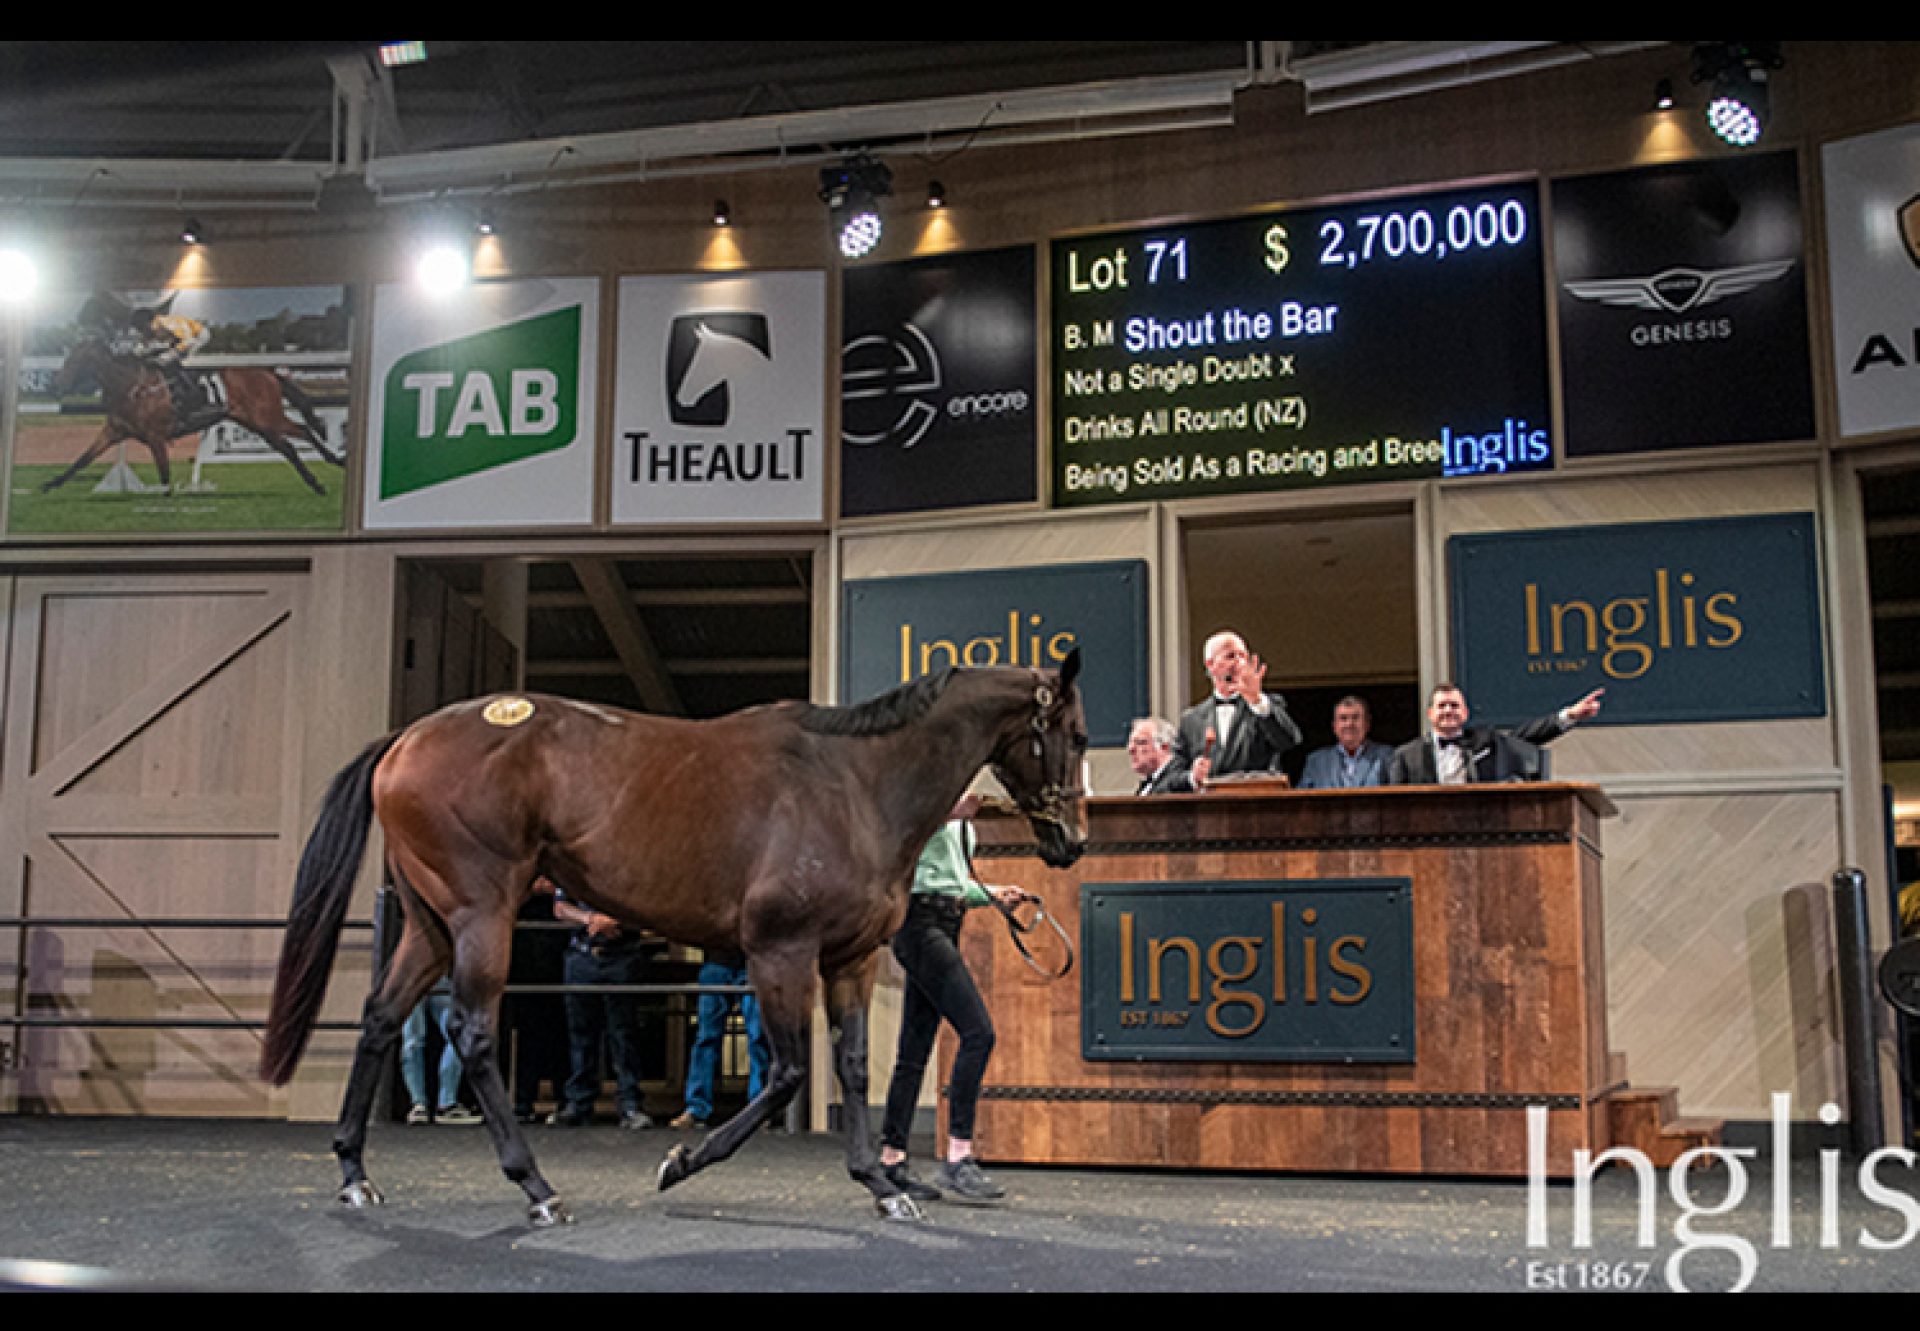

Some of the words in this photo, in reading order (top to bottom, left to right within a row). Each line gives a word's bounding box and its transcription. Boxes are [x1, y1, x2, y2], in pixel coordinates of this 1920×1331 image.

[1069, 248, 1130, 293] Lot
[1143, 237, 1188, 284] 71
[1263, 222, 1290, 275] $
[1320, 200, 1525, 268] 2,700,000
[1125, 310, 1217, 353] Shout
[1222, 307, 1273, 342] the
[1281, 300, 1340, 337] Bar
[1630, 317, 1733, 346] GENESIS
[1064, 368, 1104, 396] Not
[1108, 371, 1123, 391] a
[1128, 360, 1199, 392] Single
[1203, 353, 1274, 384] Doubt
[403, 368, 560, 438] TAB
[946, 389, 1028, 418] encore
[1065, 415, 1135, 444] Drinks
[1139, 408, 1169, 436] All
[1174, 402, 1249, 433] Round
[1253, 396, 1308, 433] (NZ)
[623, 428, 813, 484] THEAULT
[1065, 461, 1129, 494] Being
[1133, 455, 1185, 485] Sold
[1189, 453, 1221, 481] As
[1225, 456, 1241, 477] a
[1246, 446, 1328, 477] Racing
[1333, 439, 1379, 469] and
[1441, 418, 1550, 473] Inglis
[1525, 568, 1743, 679] Inglis
[1118, 901, 1374, 1038] Inglis
